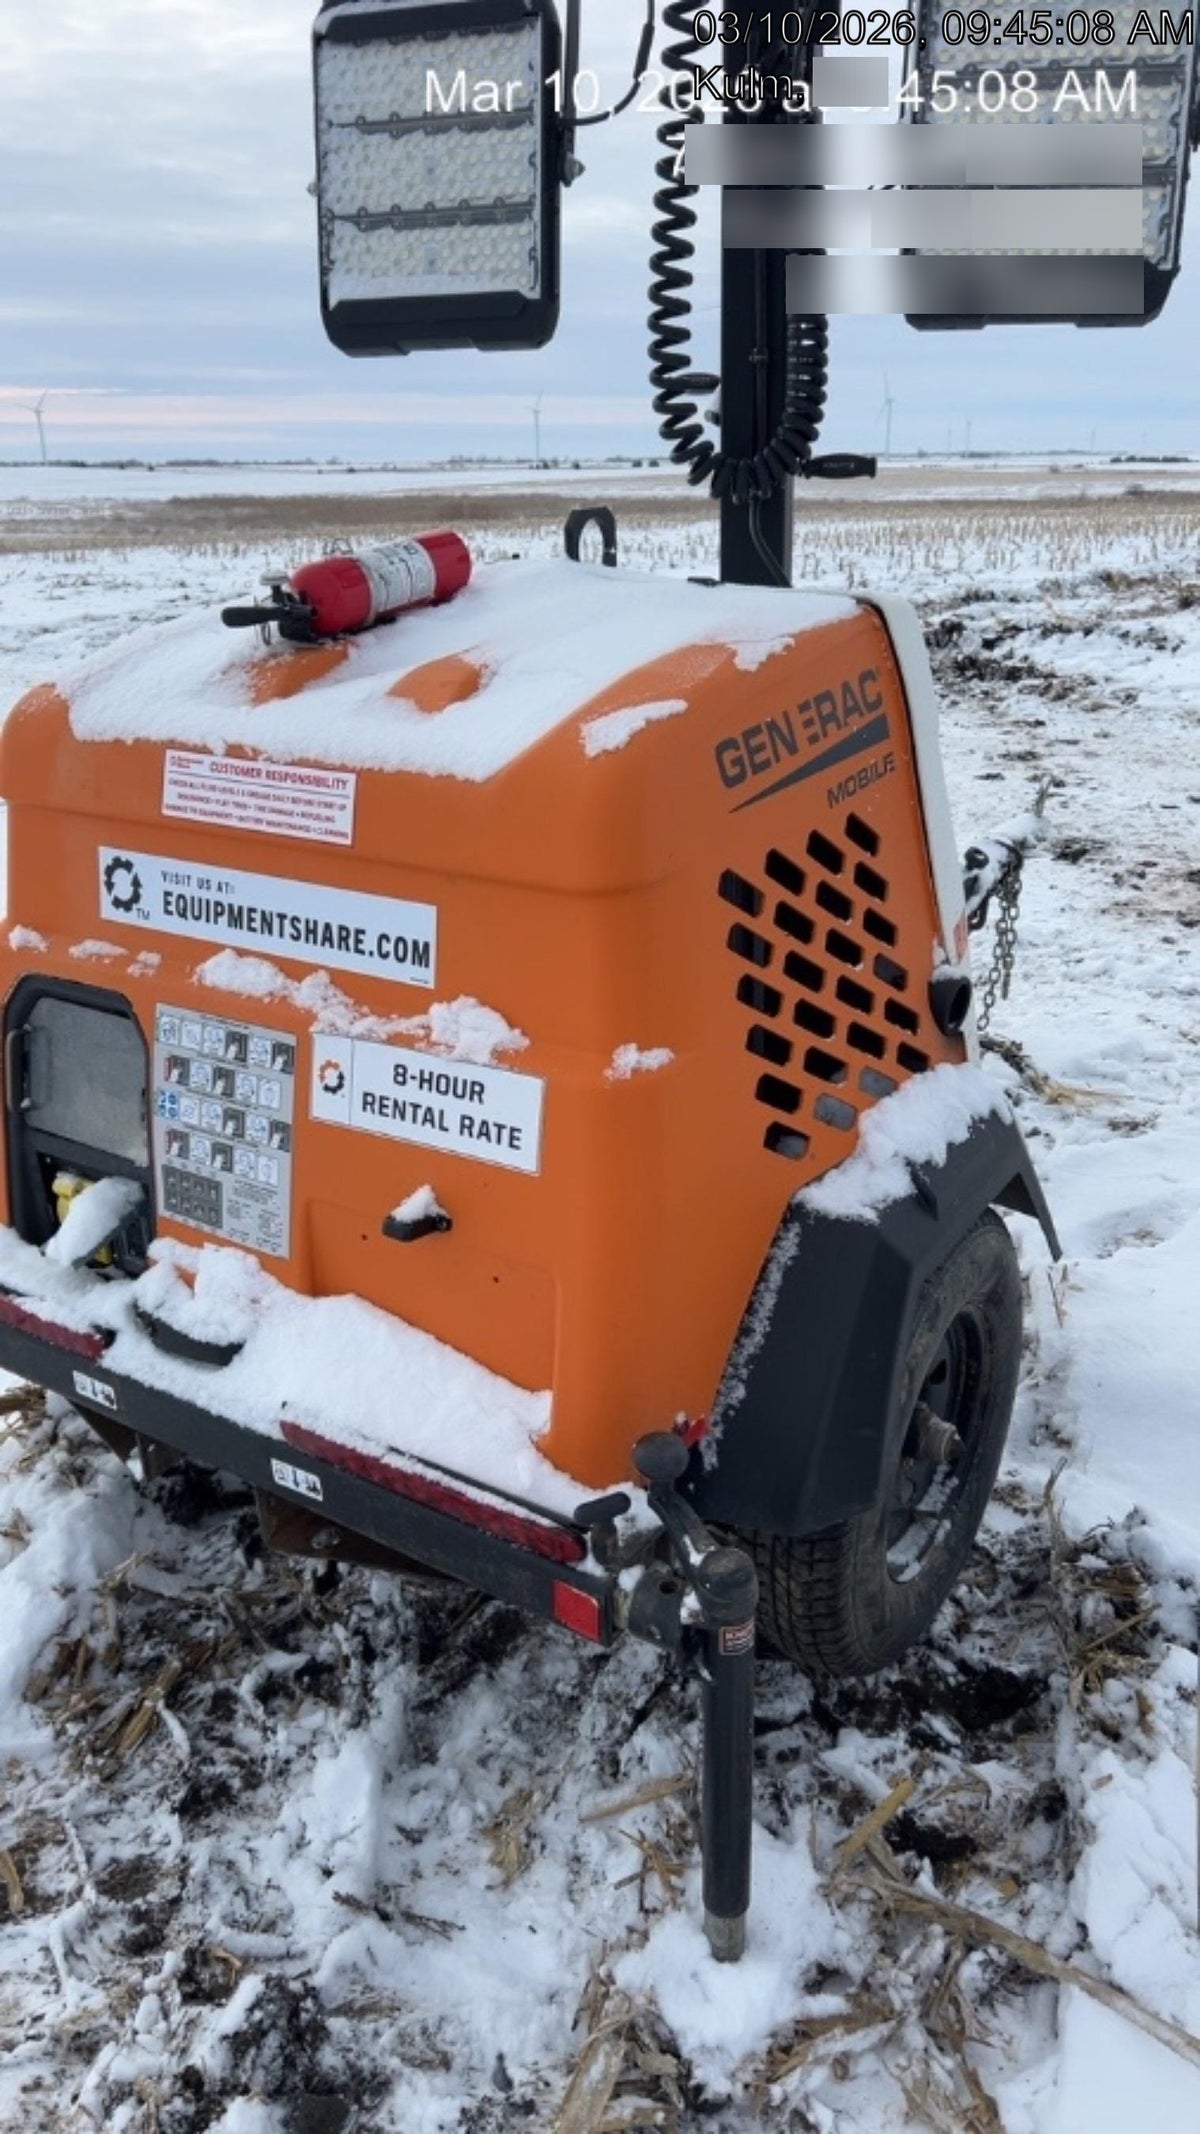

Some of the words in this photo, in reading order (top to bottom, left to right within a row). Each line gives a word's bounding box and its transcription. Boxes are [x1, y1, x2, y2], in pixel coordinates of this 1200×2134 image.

[714, 667, 884, 789] GENERAC
[209, 761, 263, 780] CUSTOMER
[265, 770, 350, 790] RESPONSIBILITY
[826, 752, 897, 809] MOBILE
[161, 869, 192, 888] VISIT
[196, 876, 212, 892] US
[135, 907, 151, 921] TM
[162, 890, 431, 969] EQUIPMENTSHARE.COM
[392, 1063, 486, 1105] 8-HOUR
[361, 1090, 450, 1132] RENTAL
[459, 1113, 523, 1151] RATE
